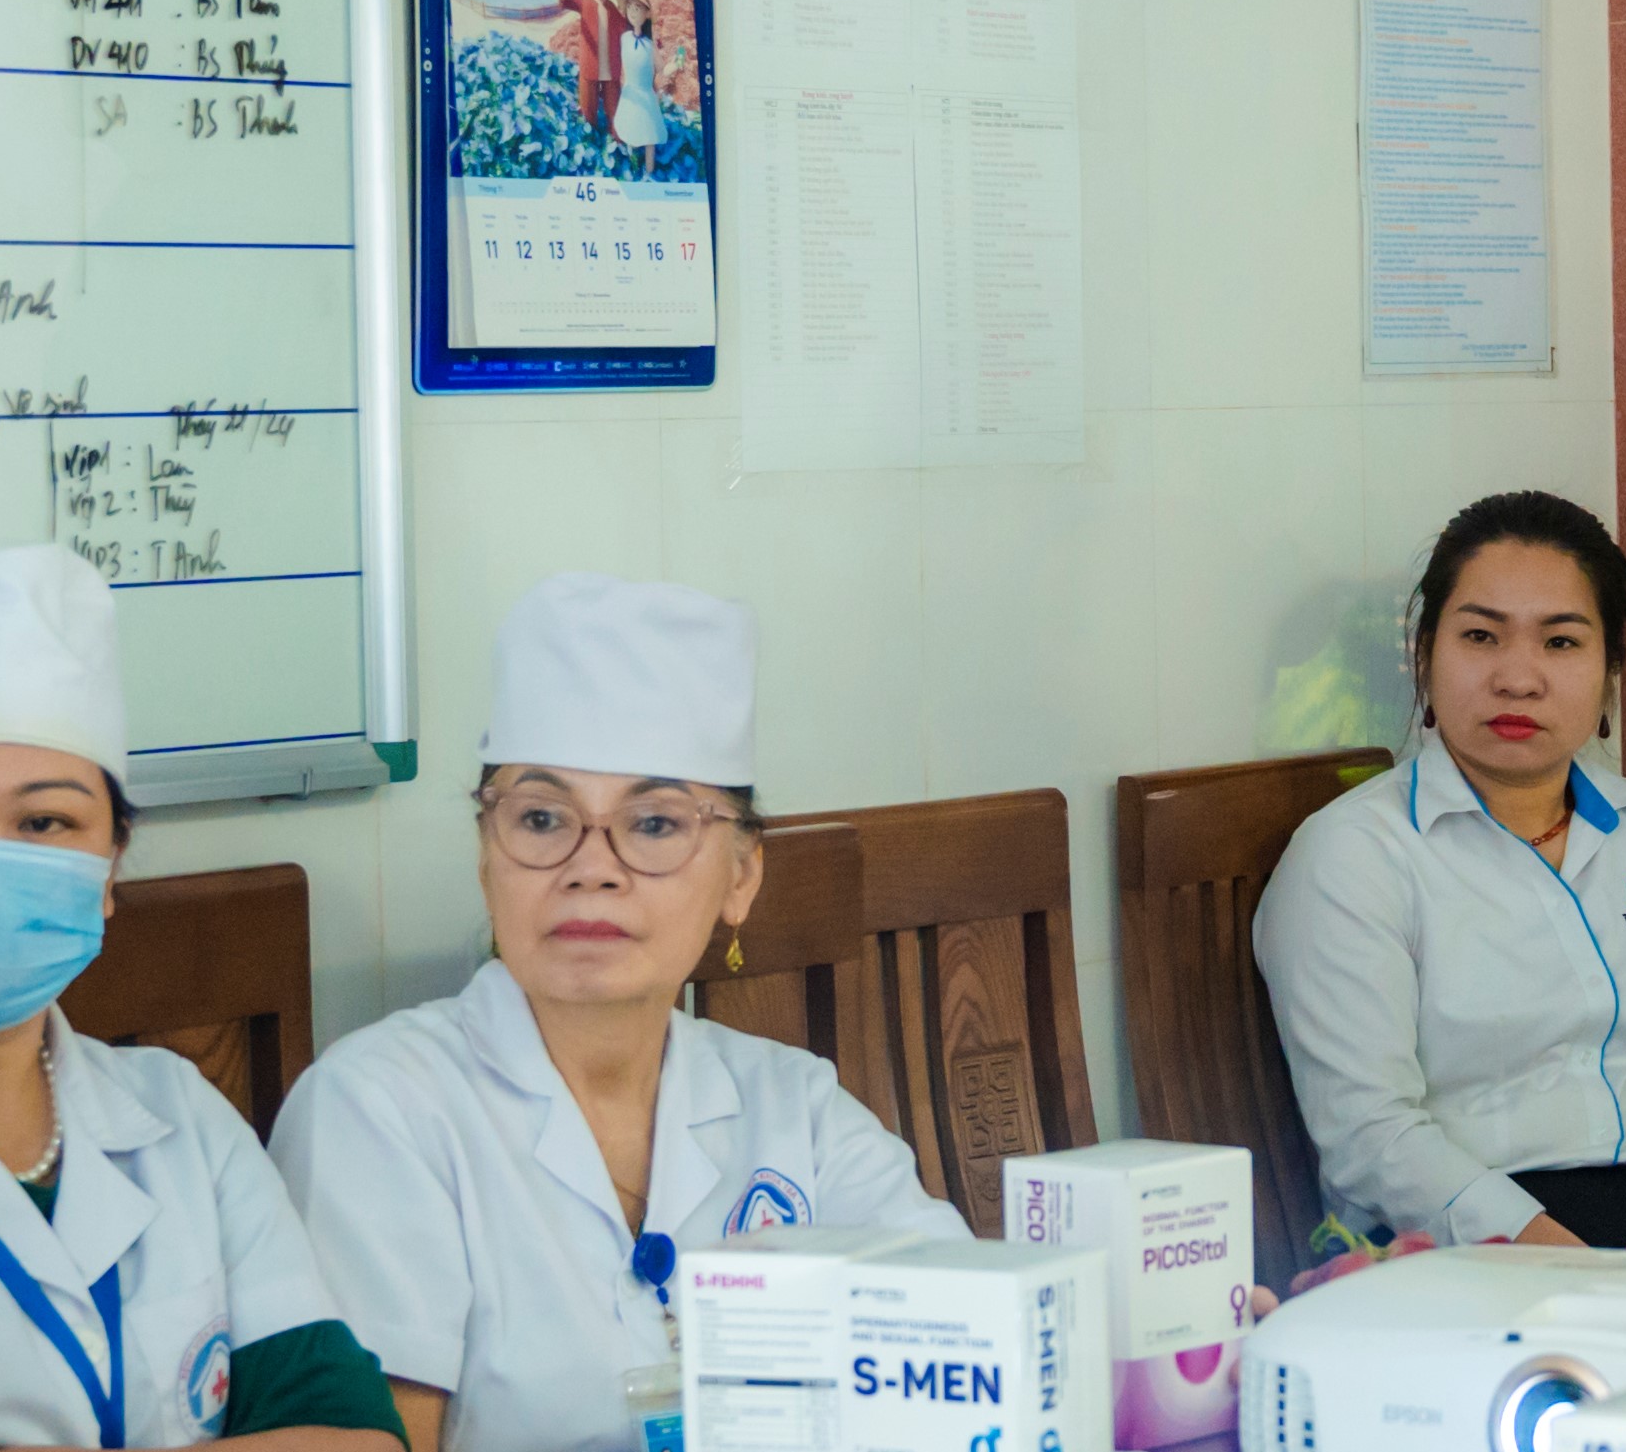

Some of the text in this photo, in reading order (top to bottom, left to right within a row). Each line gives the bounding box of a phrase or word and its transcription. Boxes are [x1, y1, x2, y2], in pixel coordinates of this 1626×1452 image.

[576, 182, 596, 202] 46
[664, 189, 694, 197] November
[485, 240, 696, 261] 11 12 13 14 15 16 17
[1038, 1285, 1058, 1412] S-MEN
[853, 1356, 1001, 1404] S-MEN
[1383, 1404, 1442, 1425] EPSON
